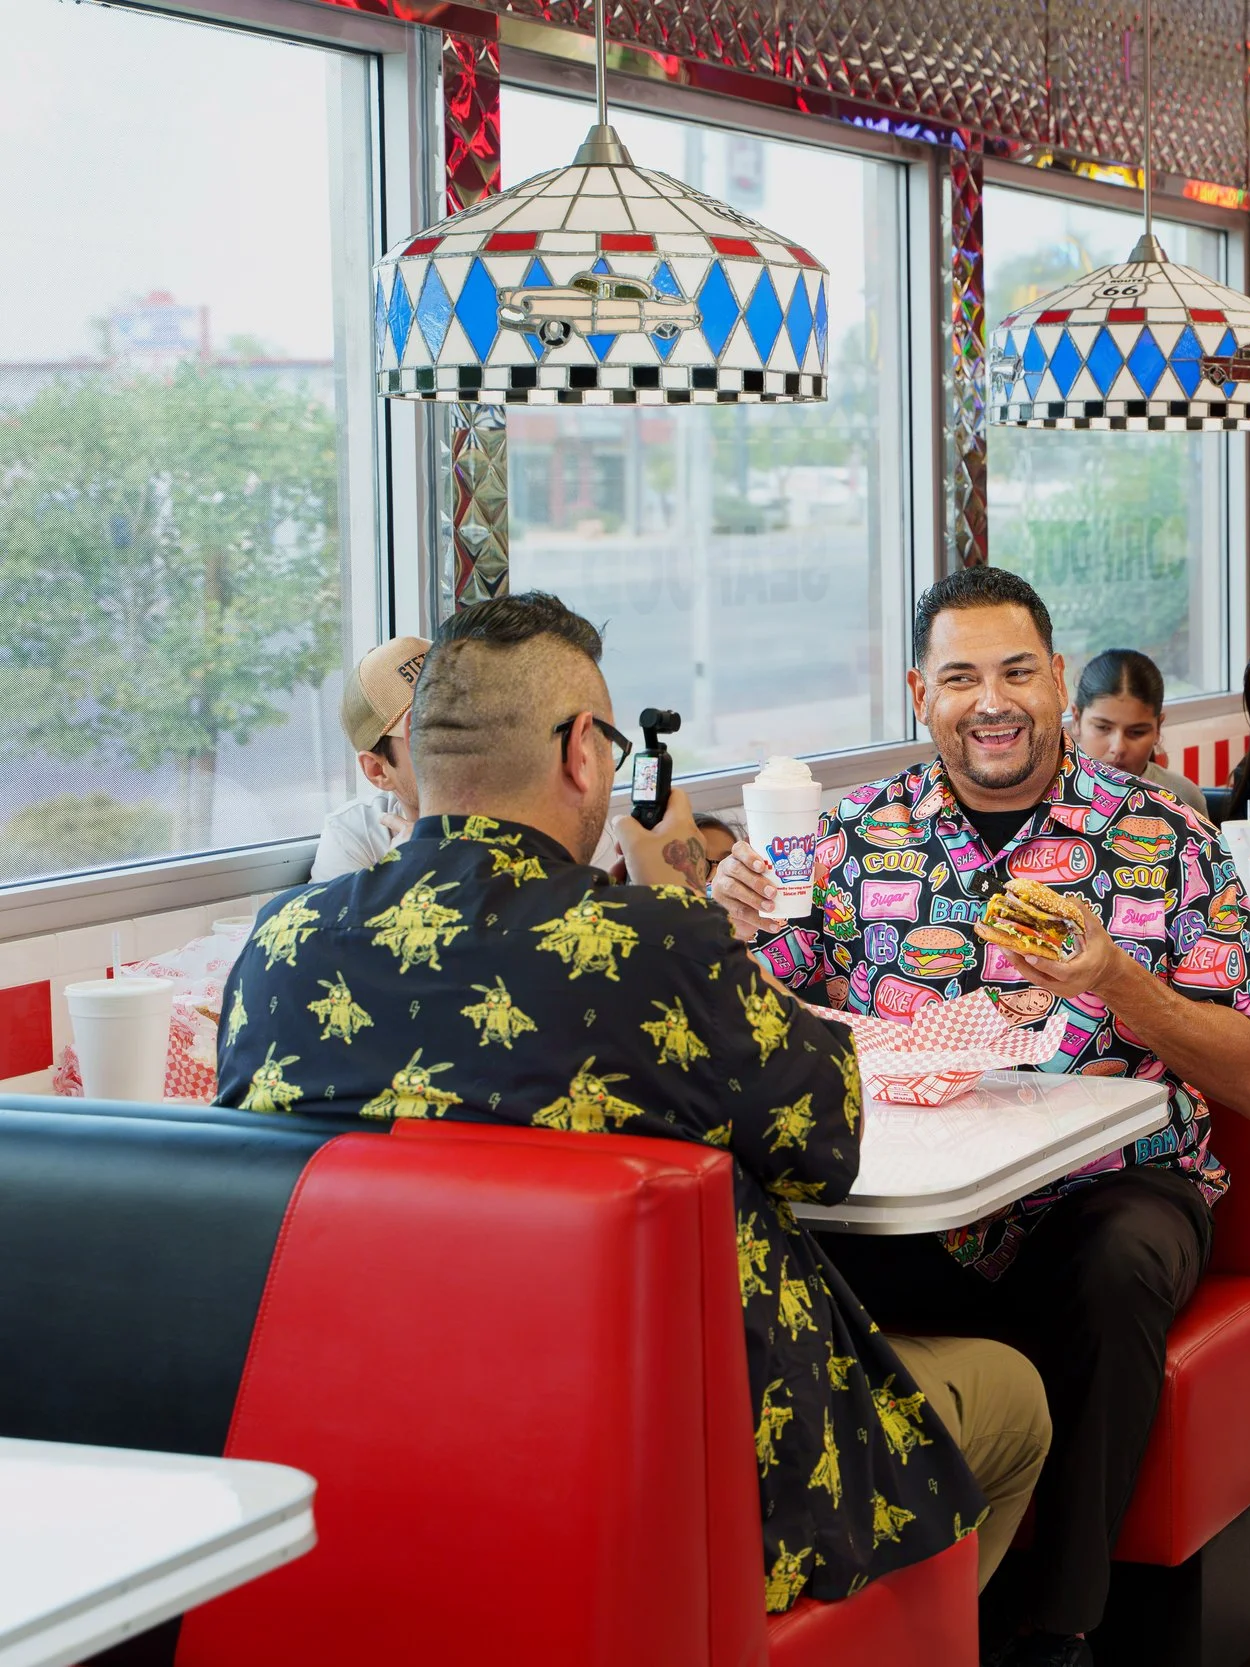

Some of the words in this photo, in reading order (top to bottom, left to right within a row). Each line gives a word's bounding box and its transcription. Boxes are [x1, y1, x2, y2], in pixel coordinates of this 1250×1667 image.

[713, 206, 756, 225] 66
[1103, 285, 1138, 296] 66
[865, 851, 928, 877] COOL
[1012, 847, 1056, 869] WOKE
[778, 869, 812, 877] BURGER
[870, 892, 910, 908] Sugar
[932, 896, 987, 923] BAM
[1122, 908, 1163, 926] Sugar
[865, 925, 898, 962] YES
[1169, 911, 1206, 954] YES
[877, 983, 913, 1013] WOKE
[1136, 1127, 1178, 1164] BAM
